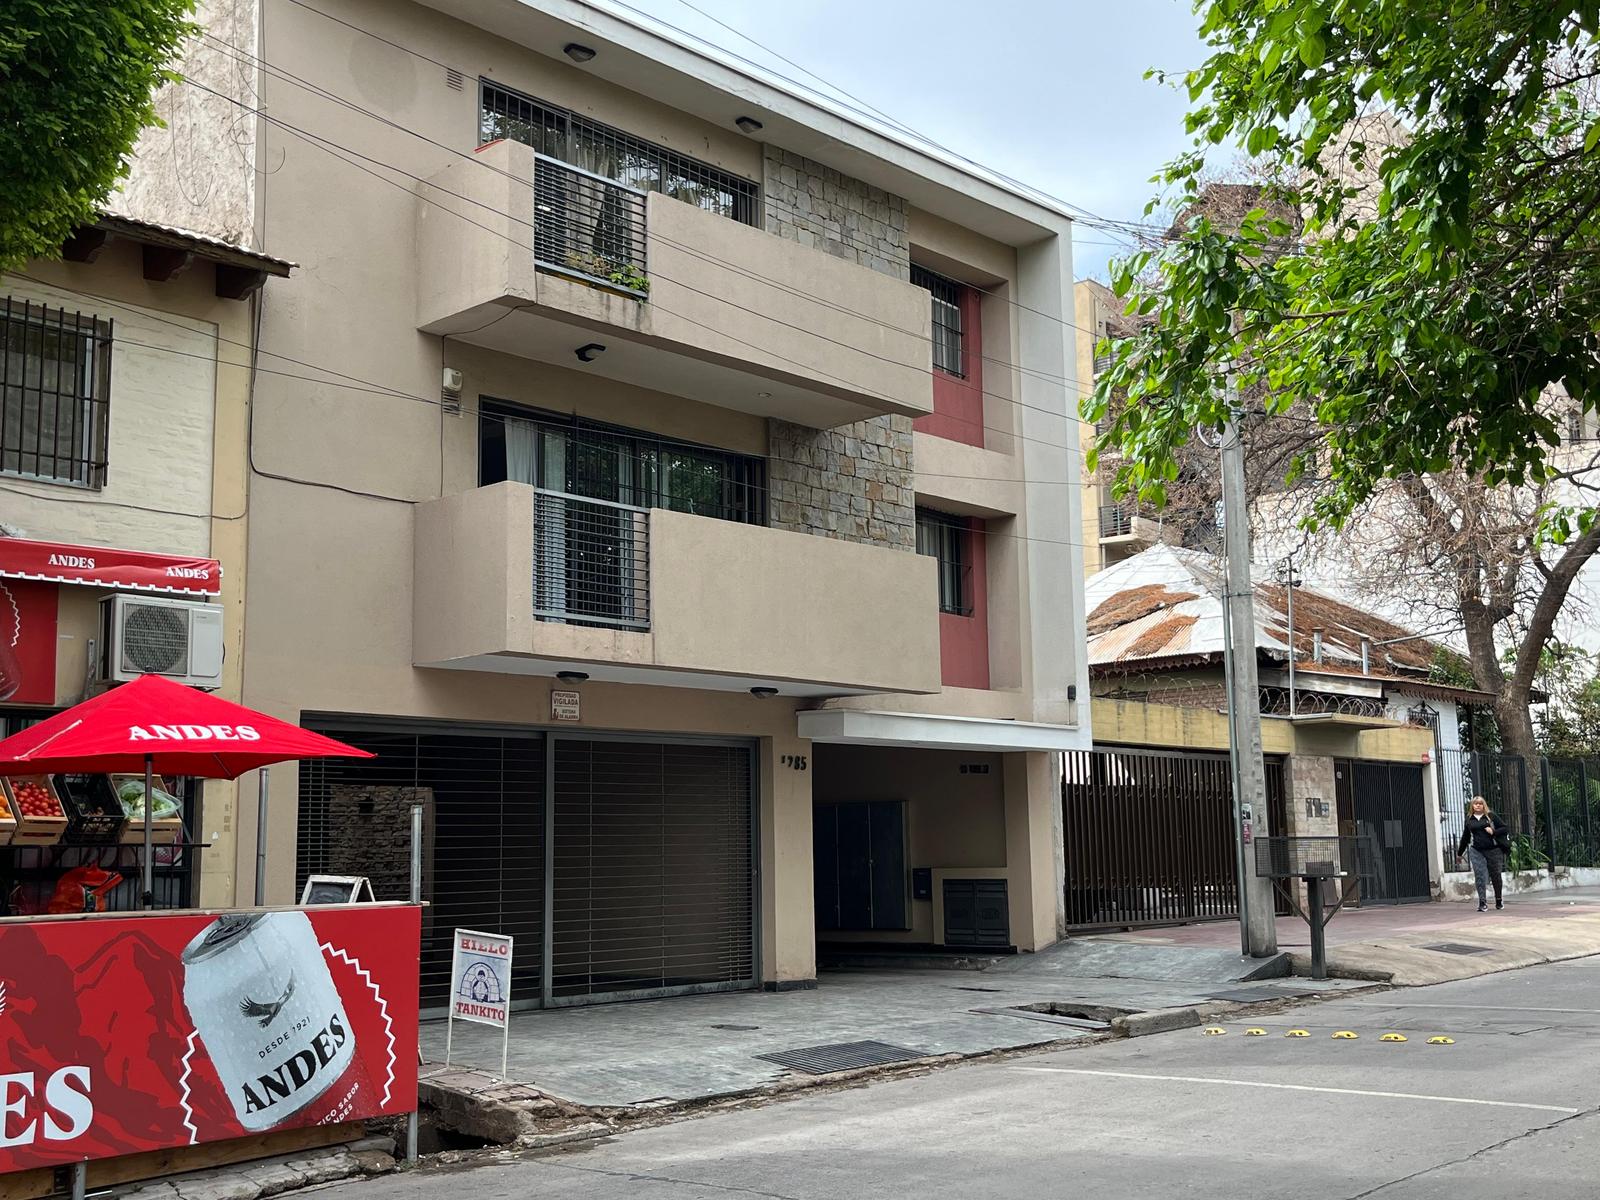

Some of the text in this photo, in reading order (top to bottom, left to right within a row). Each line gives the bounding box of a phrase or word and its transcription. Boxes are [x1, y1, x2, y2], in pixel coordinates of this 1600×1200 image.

[48, 554, 209, 580] ANDES ANDES
[128, 724, 261, 741] ANDES
[456, 1002, 505, 1021] TANKITO
[258, 1016, 311, 1058] DESDE 1921
[241, 1013, 346, 1114] ANDES
[0, 1065, 94, 1148] ES
[338, 1082, 359, 1110] SABOR
